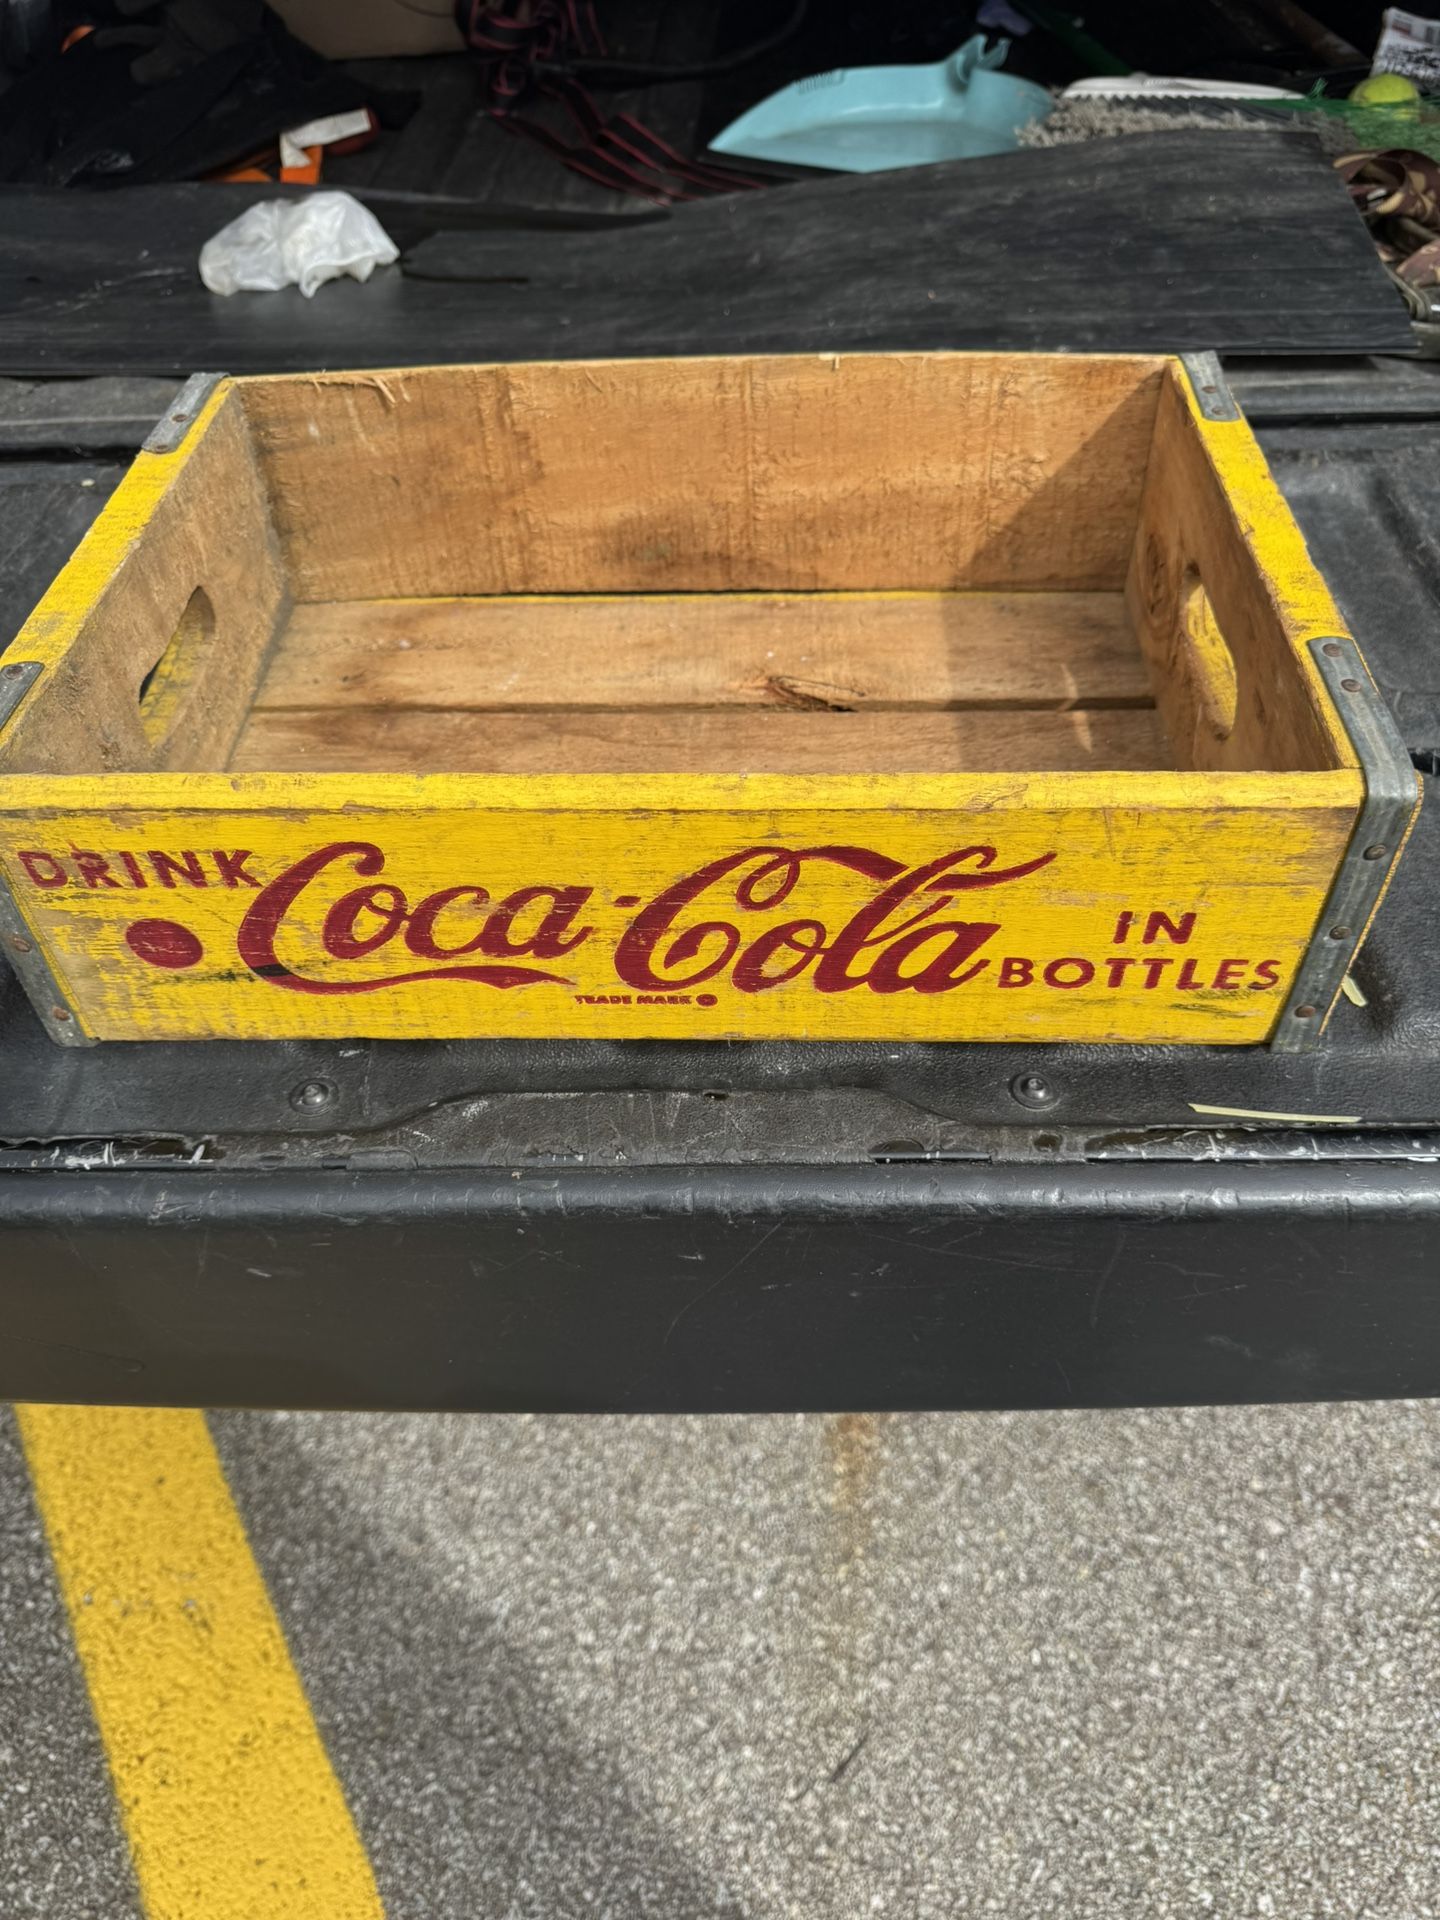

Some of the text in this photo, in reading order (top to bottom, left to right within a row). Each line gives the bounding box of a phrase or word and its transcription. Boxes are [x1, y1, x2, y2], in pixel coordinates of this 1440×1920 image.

[17, 849, 263, 889] DRINK
[237, 842, 1055, 994] Coca-Cola
[1114, 911, 1197, 945] IN
[998, 957, 1280, 990] BOTTLES
[574, 994, 692, 1005] TRADE MARK
